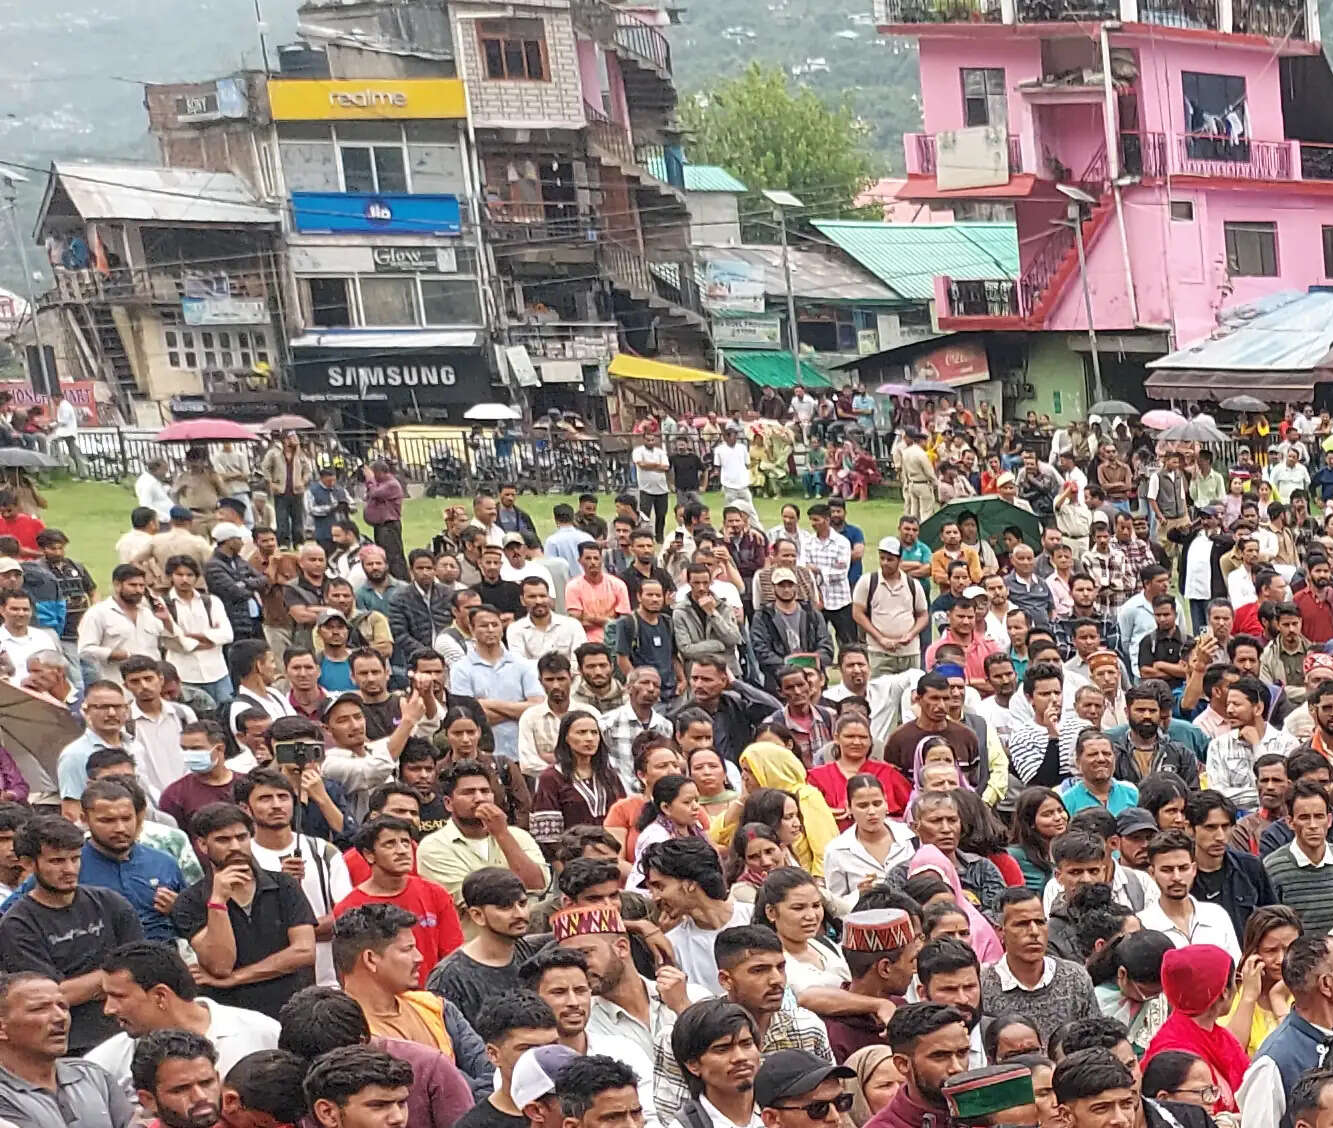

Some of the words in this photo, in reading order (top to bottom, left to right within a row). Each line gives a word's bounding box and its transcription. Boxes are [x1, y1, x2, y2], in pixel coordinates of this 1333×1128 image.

[329, 88, 408, 107] realme
[374, 247, 421, 265] Glow
[328, 365, 456, 387] SAMSUNG
